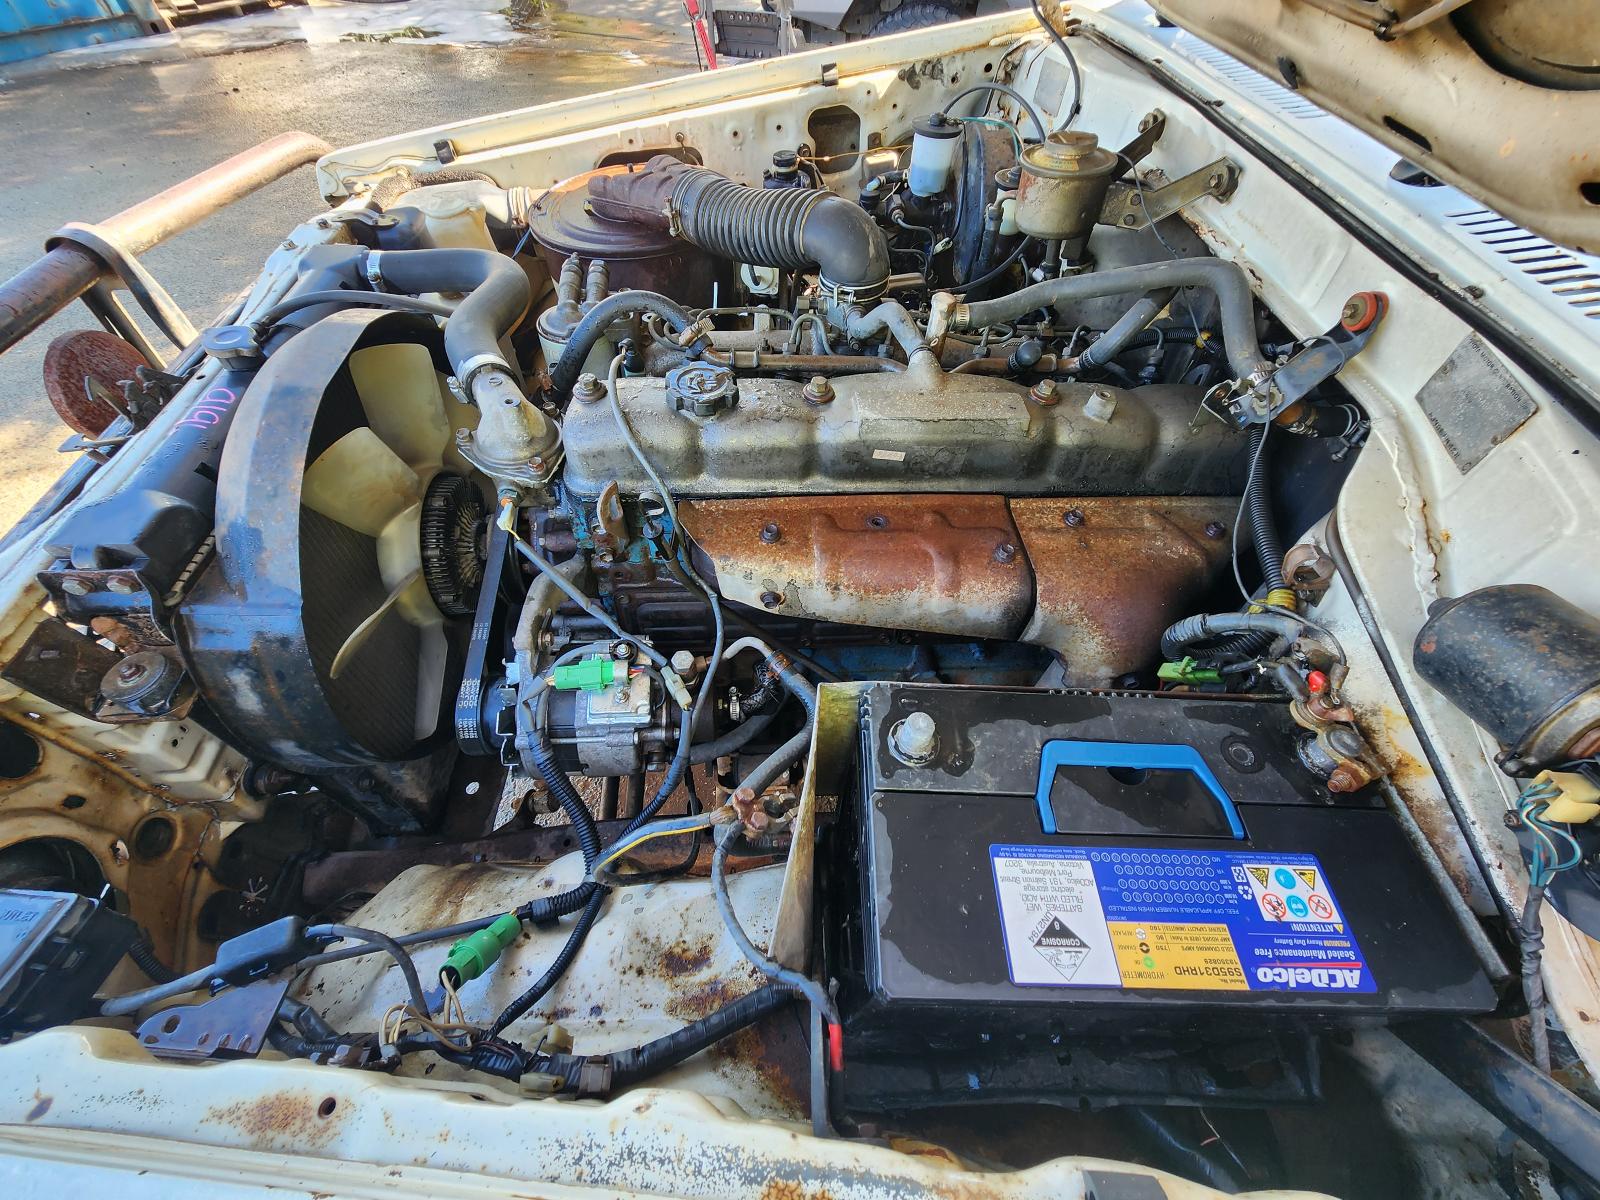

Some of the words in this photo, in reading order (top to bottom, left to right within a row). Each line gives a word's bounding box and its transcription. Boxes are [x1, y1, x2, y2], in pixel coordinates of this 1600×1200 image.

[1004, 859, 1023, 868] 3207
[1060, 869, 1072, 877] Port
[1022, 877, 1046, 886] Salmon
[1048, 877, 1062, 886] 191
[1023, 885, 1049, 893] storage
[1051, 886, 1075, 894] electric
[1040, 894, 1059, 902] WITH
[1060, 895, 1084, 903] FILLED
[1043, 903, 1083, 912] BATTERIES,
[1027, 911, 1053, 944] UN2794
[1290, 923, 1334, 932] ATTENTION!
[1040, 937, 1081, 947] CORROSIVE
[1294, 938, 1305, 946] Duty
[1306, 938, 1322, 946] Heavy
[1254, 948, 1272, 958] Free
[1274, 948, 1326, 959] Maintenance
[1327, 950, 1355, 960] Sealed
[1121, 970, 1165, 979] HYDROMETER
[1174, 966, 1242, 977] S95D31RHD
[1257, 967, 1361, 988] ACDelco
